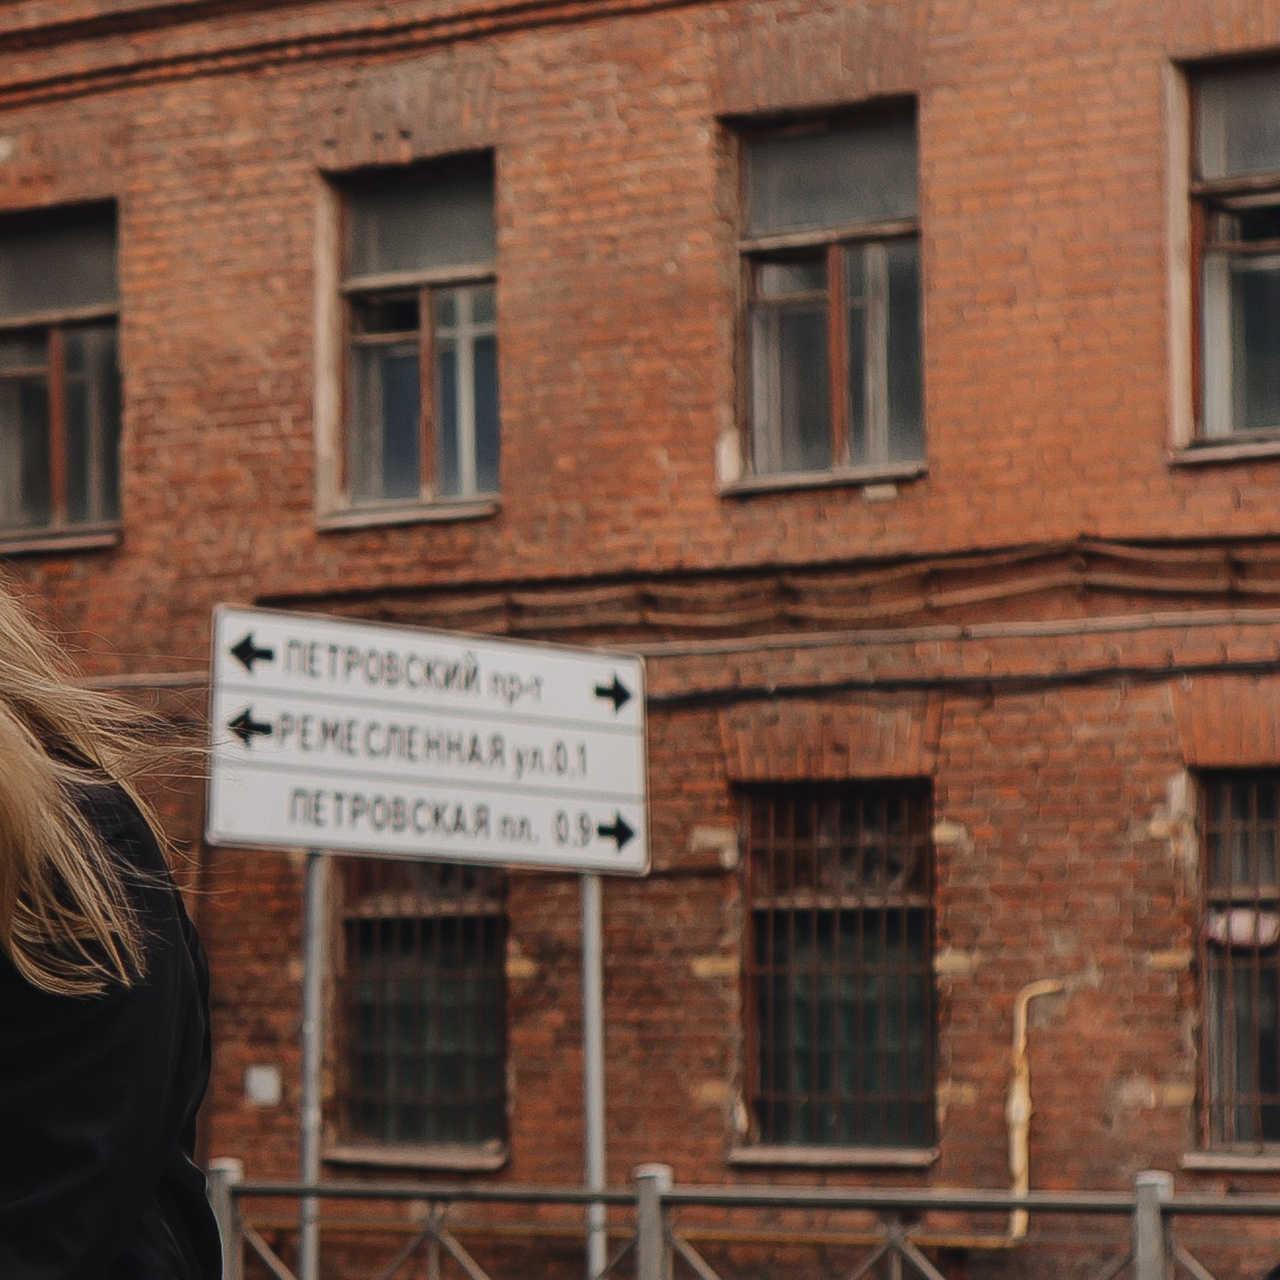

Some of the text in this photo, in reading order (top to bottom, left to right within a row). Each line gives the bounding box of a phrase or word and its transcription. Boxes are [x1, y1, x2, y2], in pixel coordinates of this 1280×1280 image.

[285, 639, 542, 705] ПЕТРОВСКИЙ пр-т
[278, 712, 505, 765] РЕМЕСЛЕННАЯ
[290, 787, 592, 847] ПЕТРОВСКАЯ пл. 0.9
